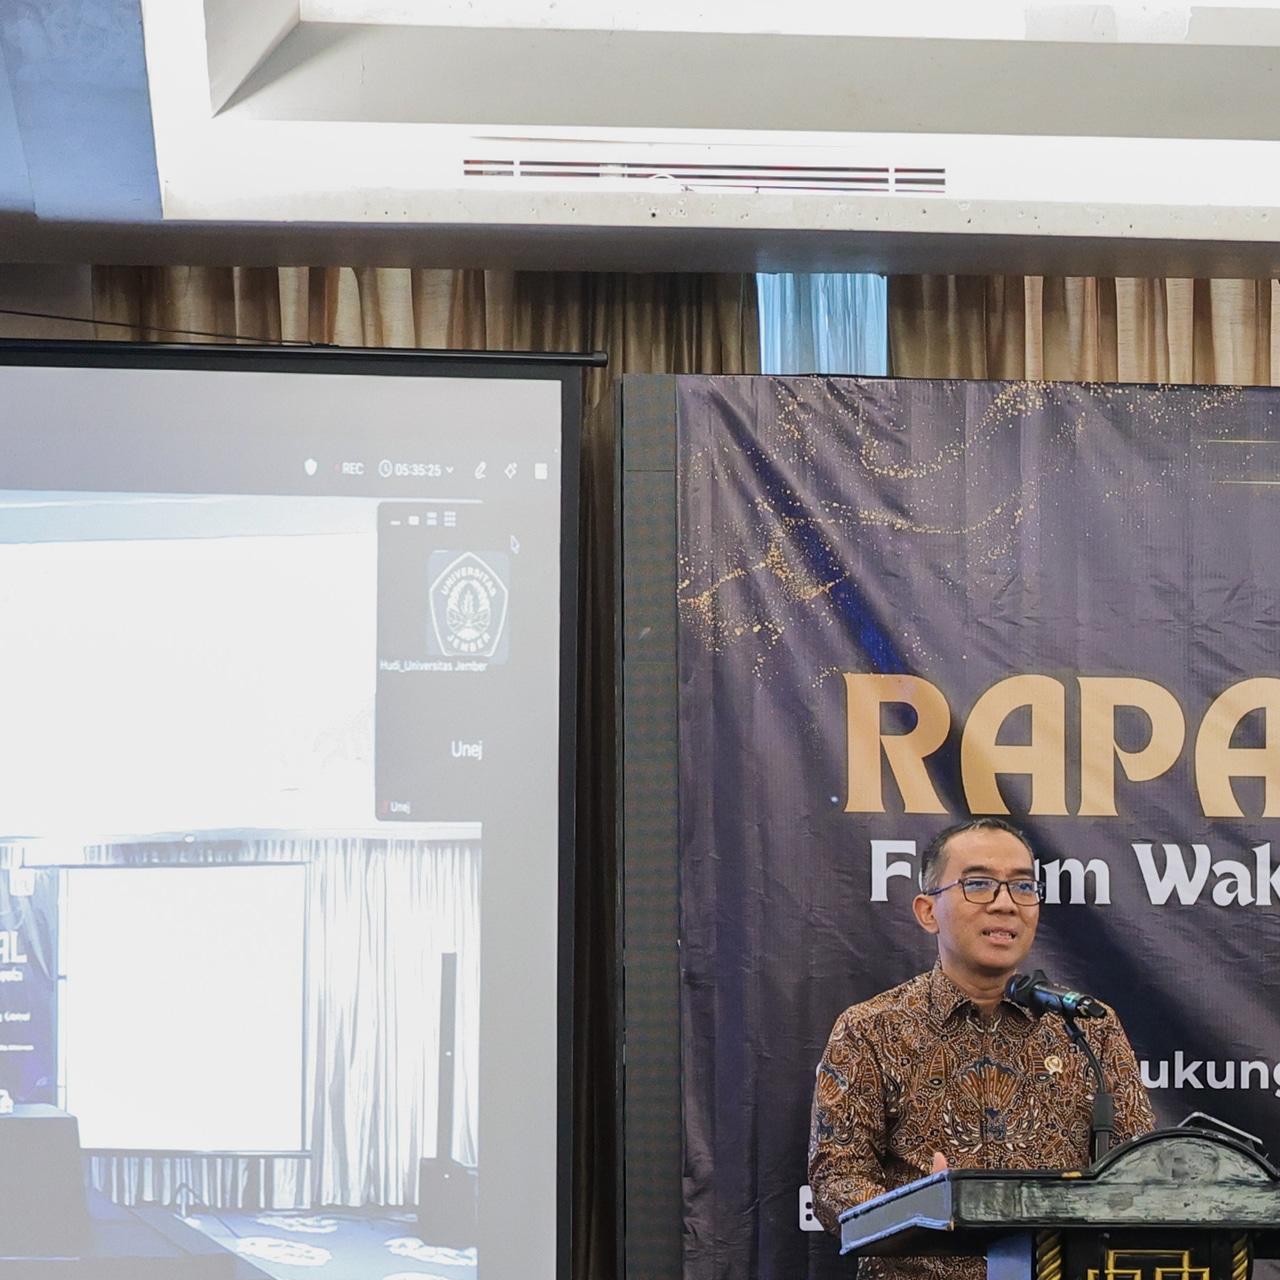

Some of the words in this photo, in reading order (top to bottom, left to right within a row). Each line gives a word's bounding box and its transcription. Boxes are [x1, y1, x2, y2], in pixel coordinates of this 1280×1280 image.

[342, 462, 364, 475] REC
[440, 567, 497, 597] UNIVERSITAS
[447, 632, 491, 652] JEMBER
[455, 661, 488, 672] Jember
[451, 740, 483, 760] Unej
[390, 801, 411, 814] Unej
